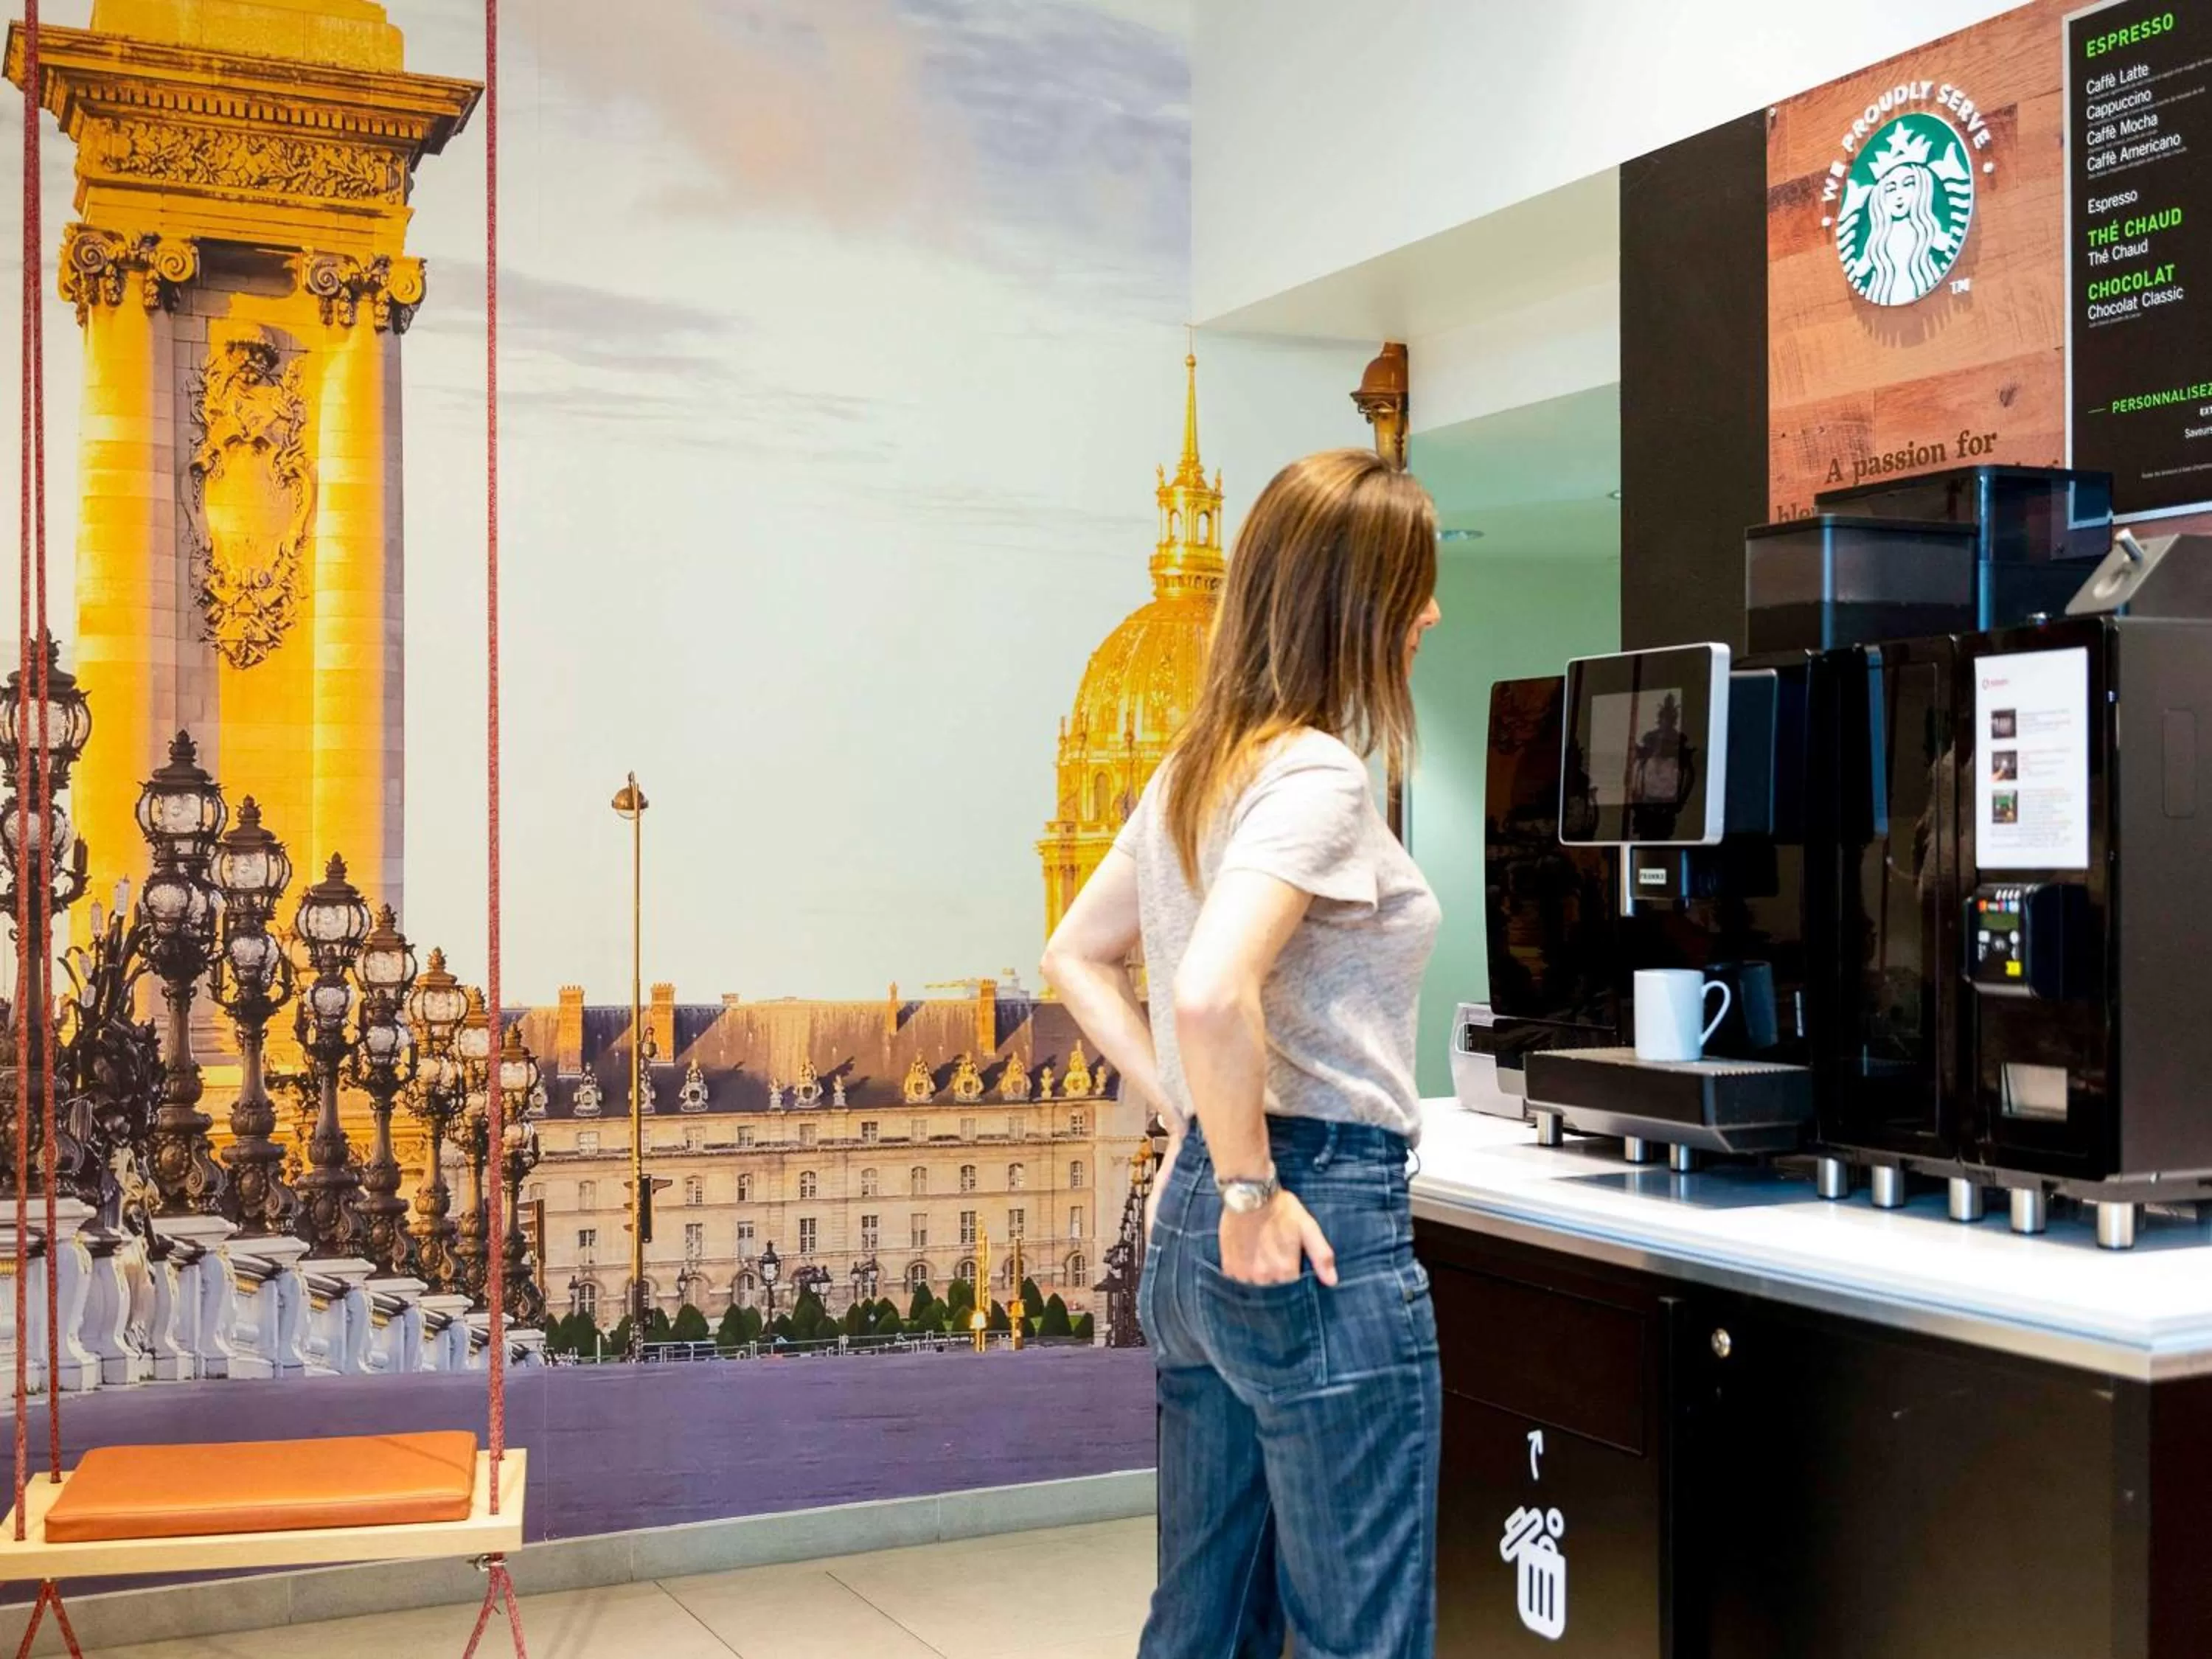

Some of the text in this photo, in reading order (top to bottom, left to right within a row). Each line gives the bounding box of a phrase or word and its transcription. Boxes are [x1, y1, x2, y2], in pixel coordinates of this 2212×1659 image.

[2086, 13, 2174, 58] ESPRESSO
[2086, 72, 2116, 95] Caffè
[2120, 64, 2150, 83] Latte
[1842, 80, 1934, 153] PROUDLY
[1936, 83, 1992, 150] SERVE
[2086, 89, 2152, 119] Cappuccino
[2086, 125, 2117, 146] Caffè
[2120, 114, 2159, 136] Mocha
[2087, 151, 2117, 171] Caffè
[2120, 133, 2182, 161] Americano
[2087, 189, 2138, 214] Espresso
[2088, 207, 2182, 247] THÉ CHAUD
[2087, 238, 2149, 267] Thé Chaud
[2088, 264, 2175, 300] CHOCOLAT
[2087, 285, 2184, 319] Chocolat Classic
[1824, 430, 1997, 485] A passion for
